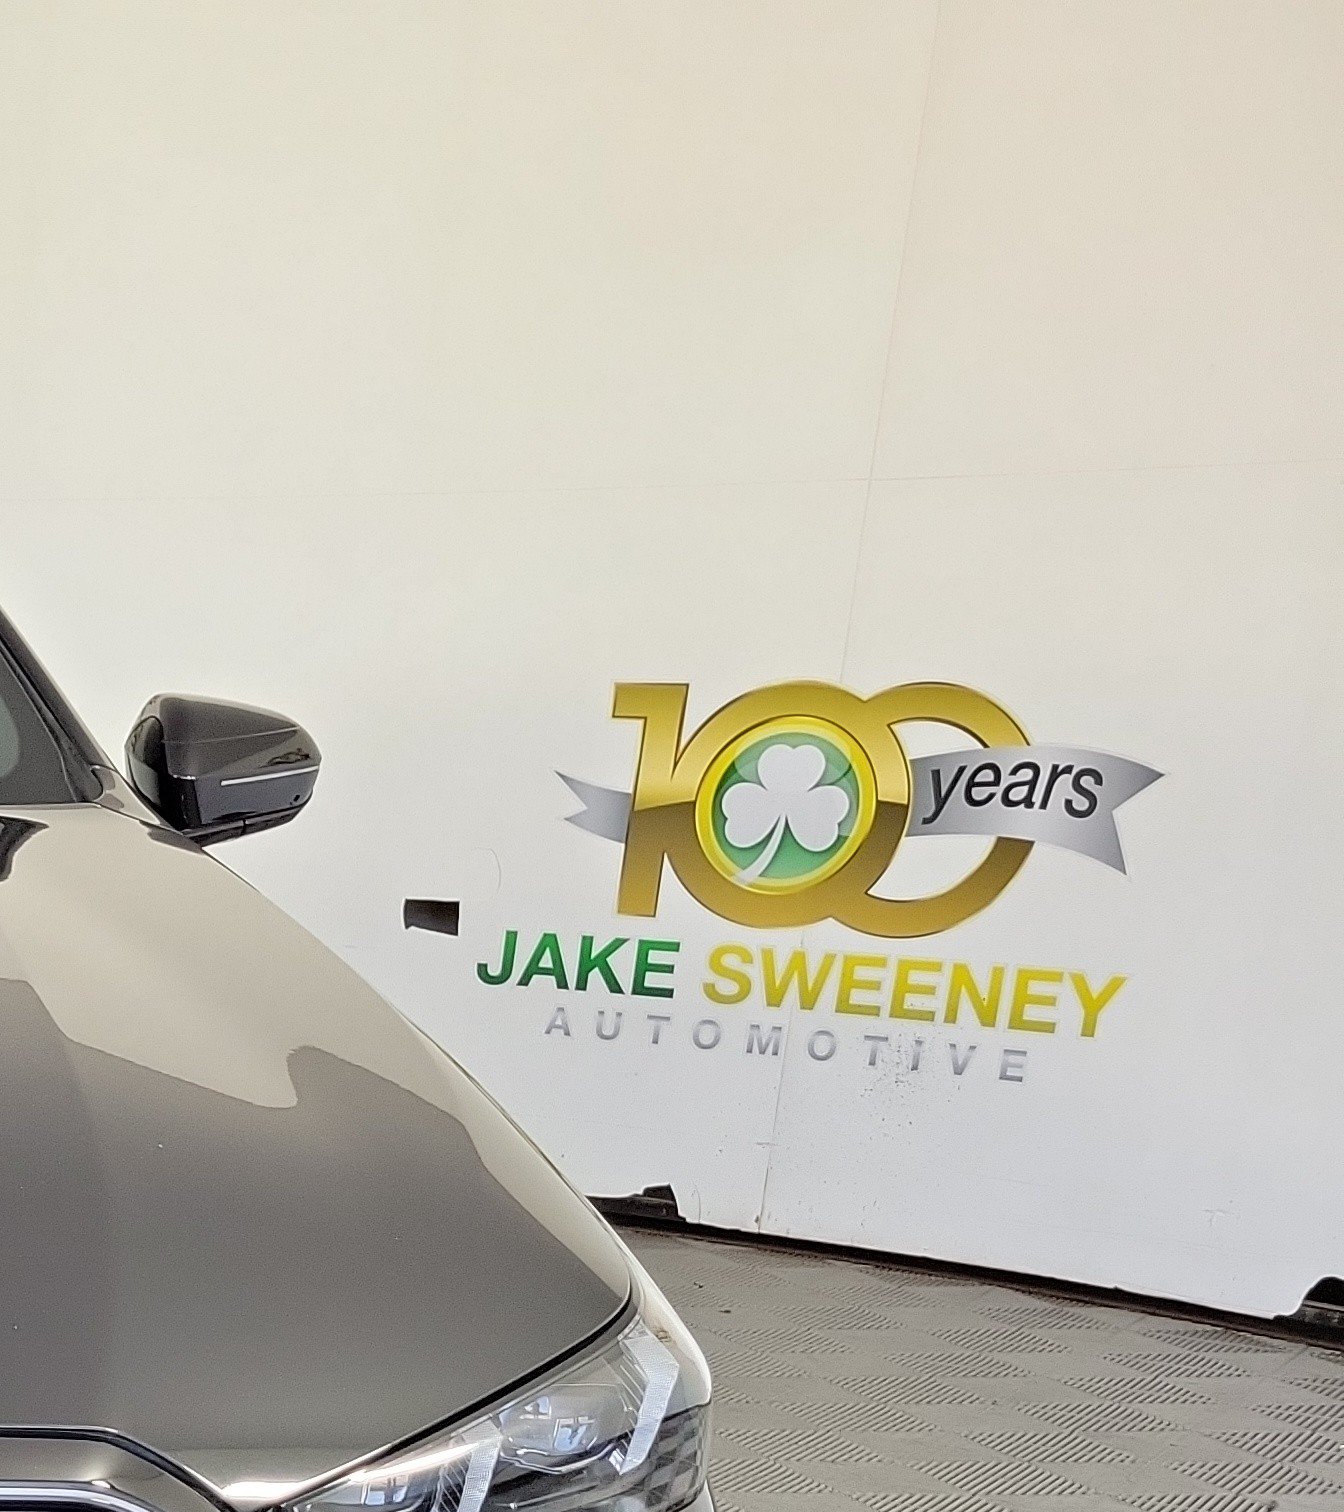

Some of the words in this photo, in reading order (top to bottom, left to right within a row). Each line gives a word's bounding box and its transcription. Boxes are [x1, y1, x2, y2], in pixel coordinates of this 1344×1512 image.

[612, 680, 1034, 938] 100
[921, 758, 1104, 827] years
[476, 930, 681, 999] JAKE
[701, 945, 1128, 1038] SWEENEY
[544, 1006, 1029, 1083] AUTOMOTIVE
